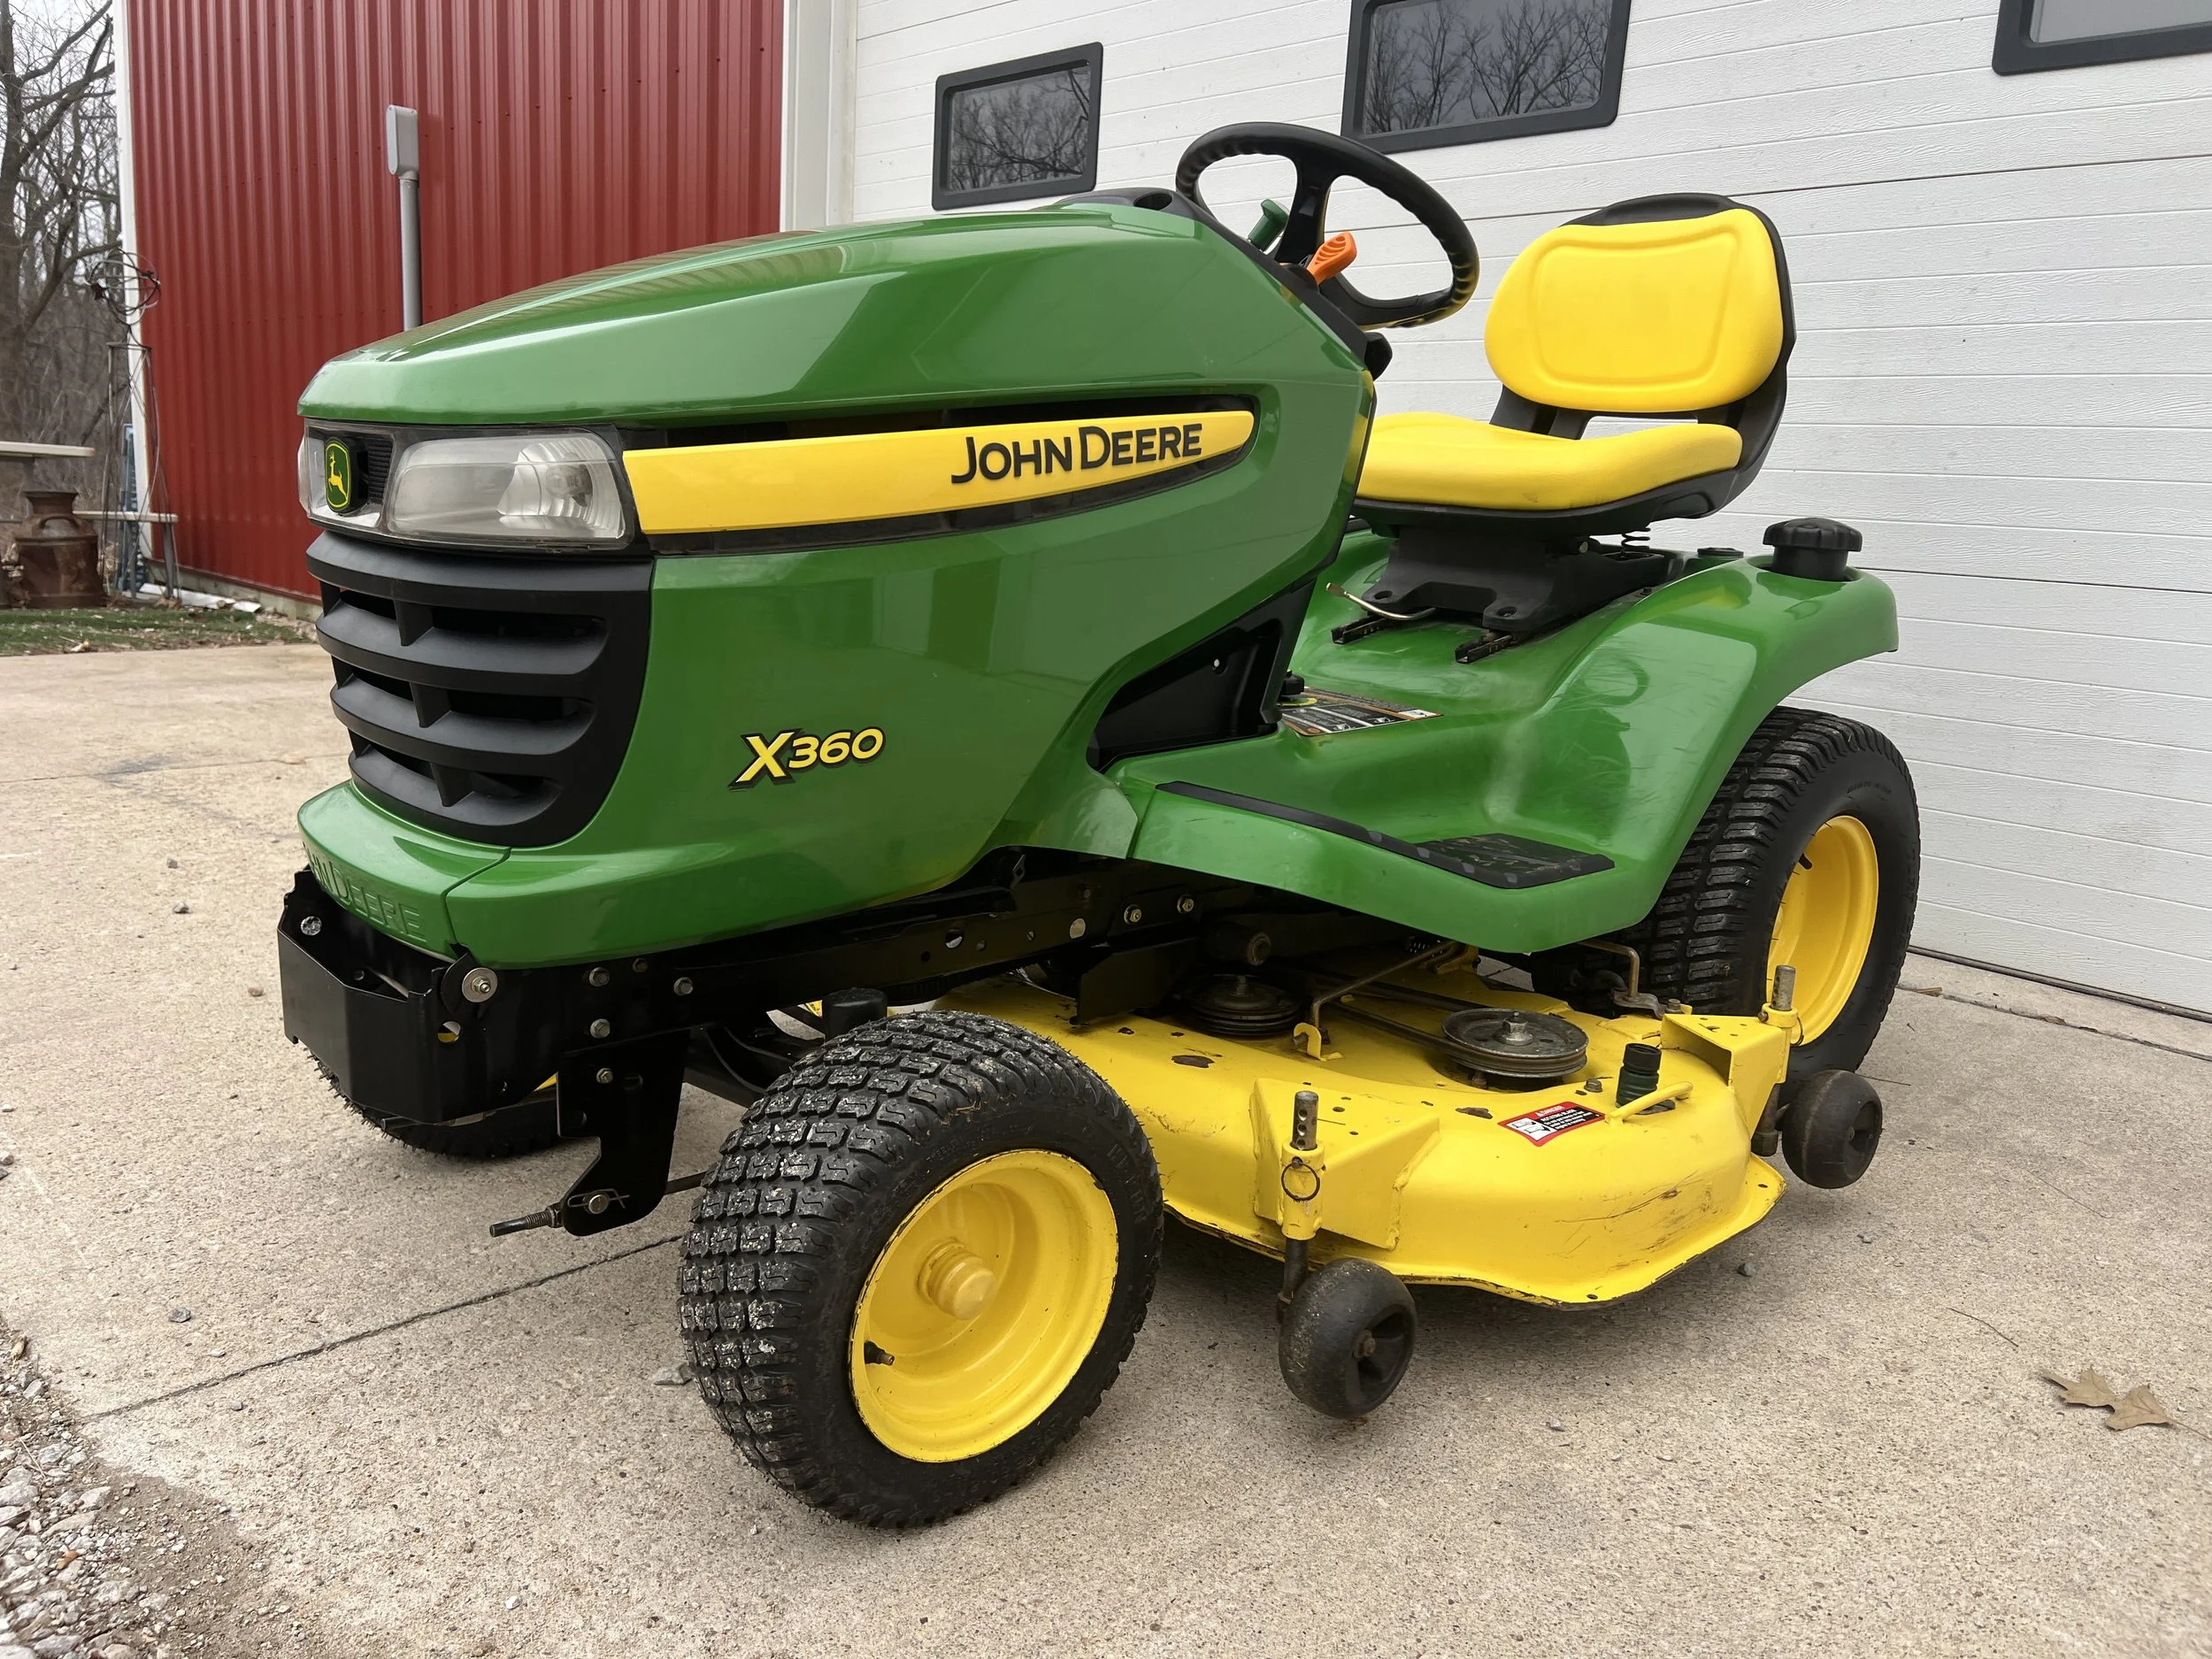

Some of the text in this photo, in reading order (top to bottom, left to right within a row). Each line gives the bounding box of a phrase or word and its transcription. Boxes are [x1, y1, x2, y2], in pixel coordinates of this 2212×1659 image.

[951, 423, 1202, 484] JOHN DEERE
[727, 727, 885, 787] X360
[328, 859, 427, 942] DEERE
